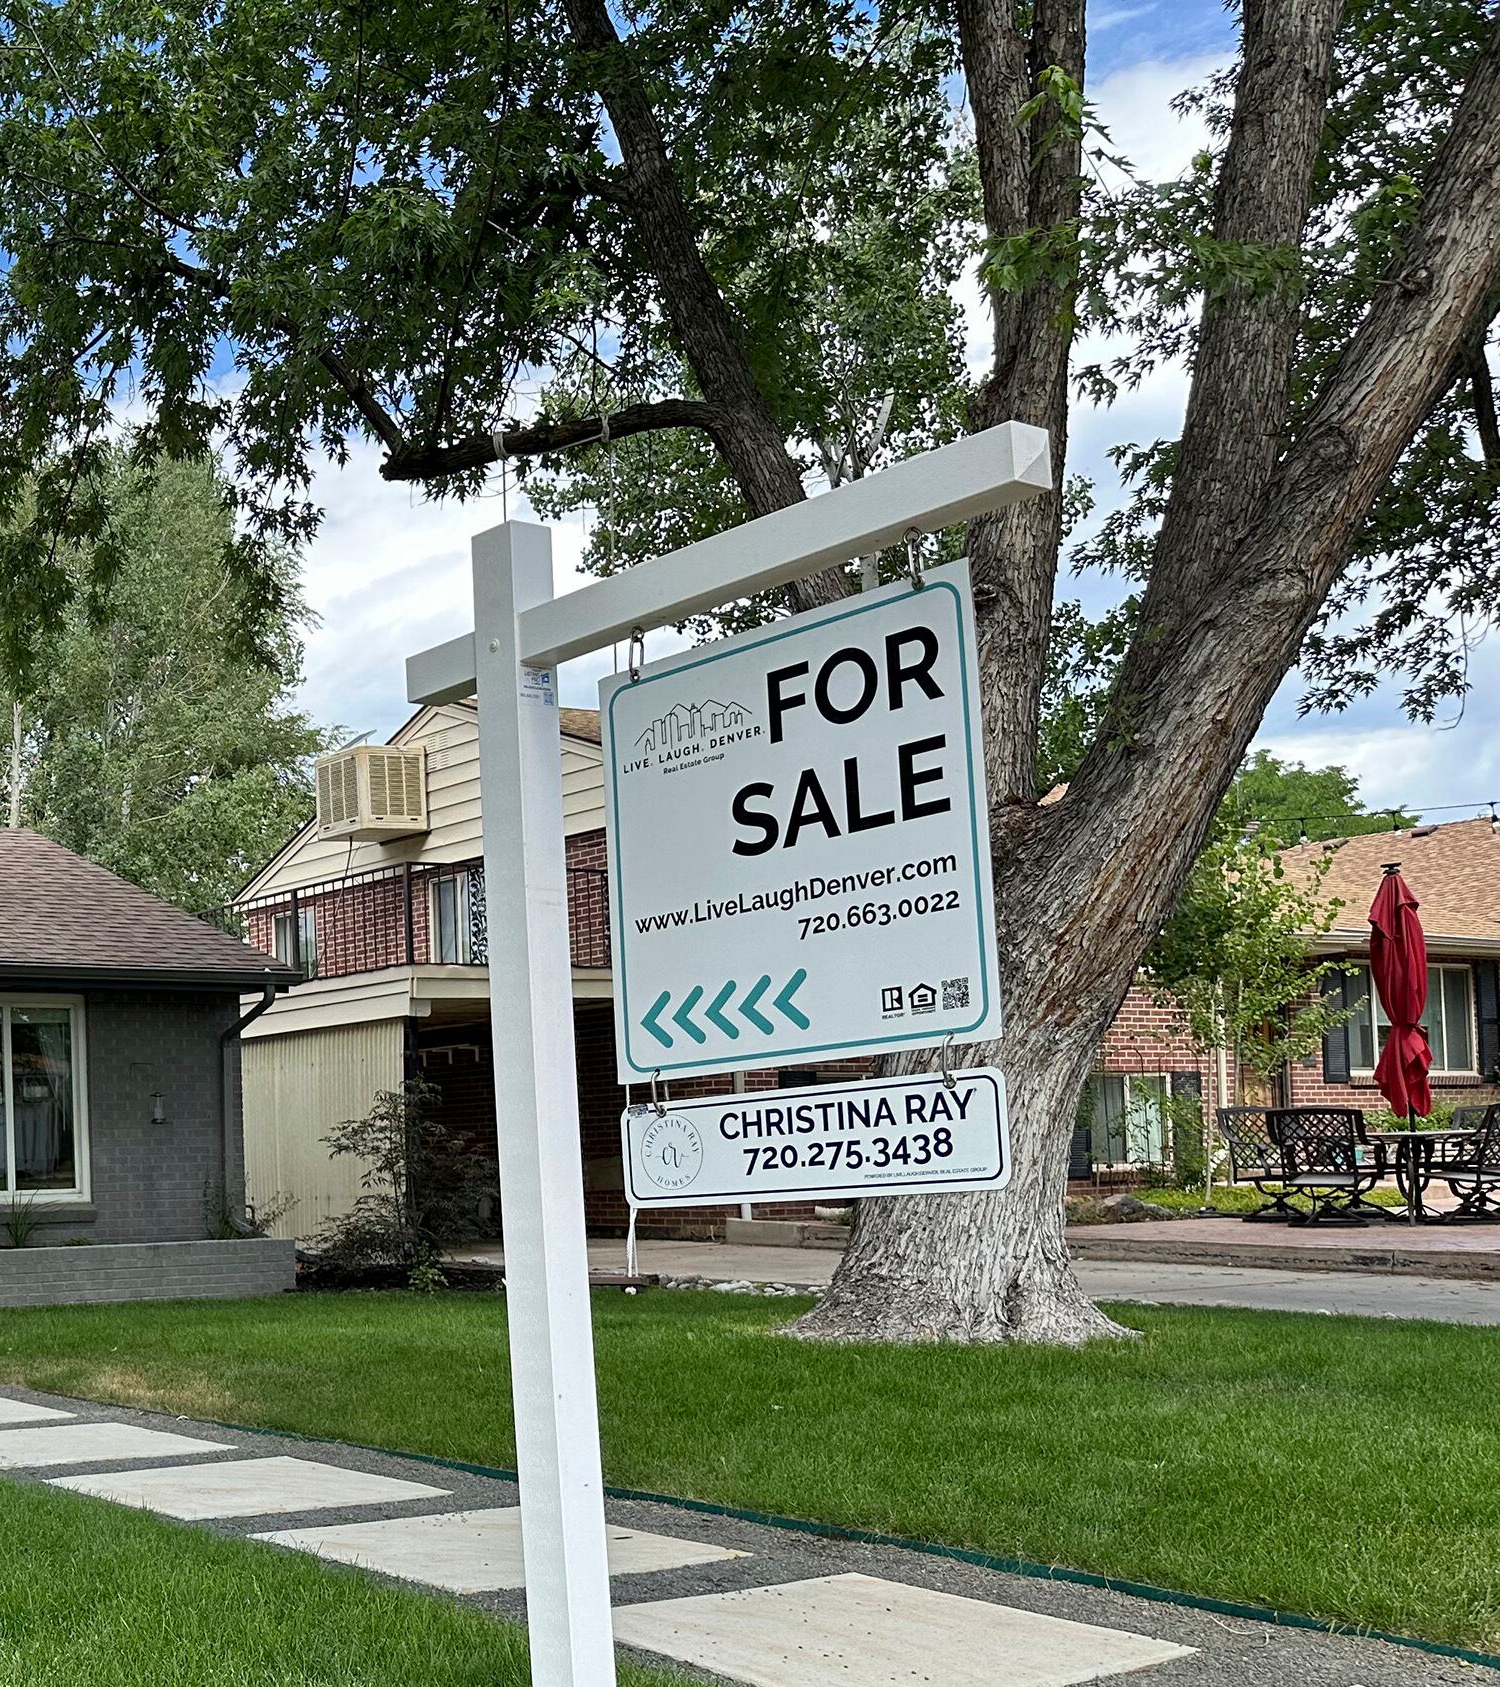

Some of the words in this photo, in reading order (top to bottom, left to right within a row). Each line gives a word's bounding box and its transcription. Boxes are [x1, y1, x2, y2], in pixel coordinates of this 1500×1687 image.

[766, 626, 946, 745] FOR
[663, 764, 679, 775] Real
[680, 759, 701, 770] Estate
[702, 753, 725, 764] Group
[731, 733, 952, 857] SALE
[635, 853, 958, 934] www.LiveLaughDenver.com
[798, 889, 961, 940] 720.663.0022
[645, 1119, 687, 1158] CHRISTINA
[687, 1131, 700, 1154] RAY
[719, 1097, 897, 1140] CHRISTINA
[905, 1088, 975, 1125] RAY
[743, 1127, 954, 1176] 720.275.3438
[656, 1174, 691, 1187] HOMES
